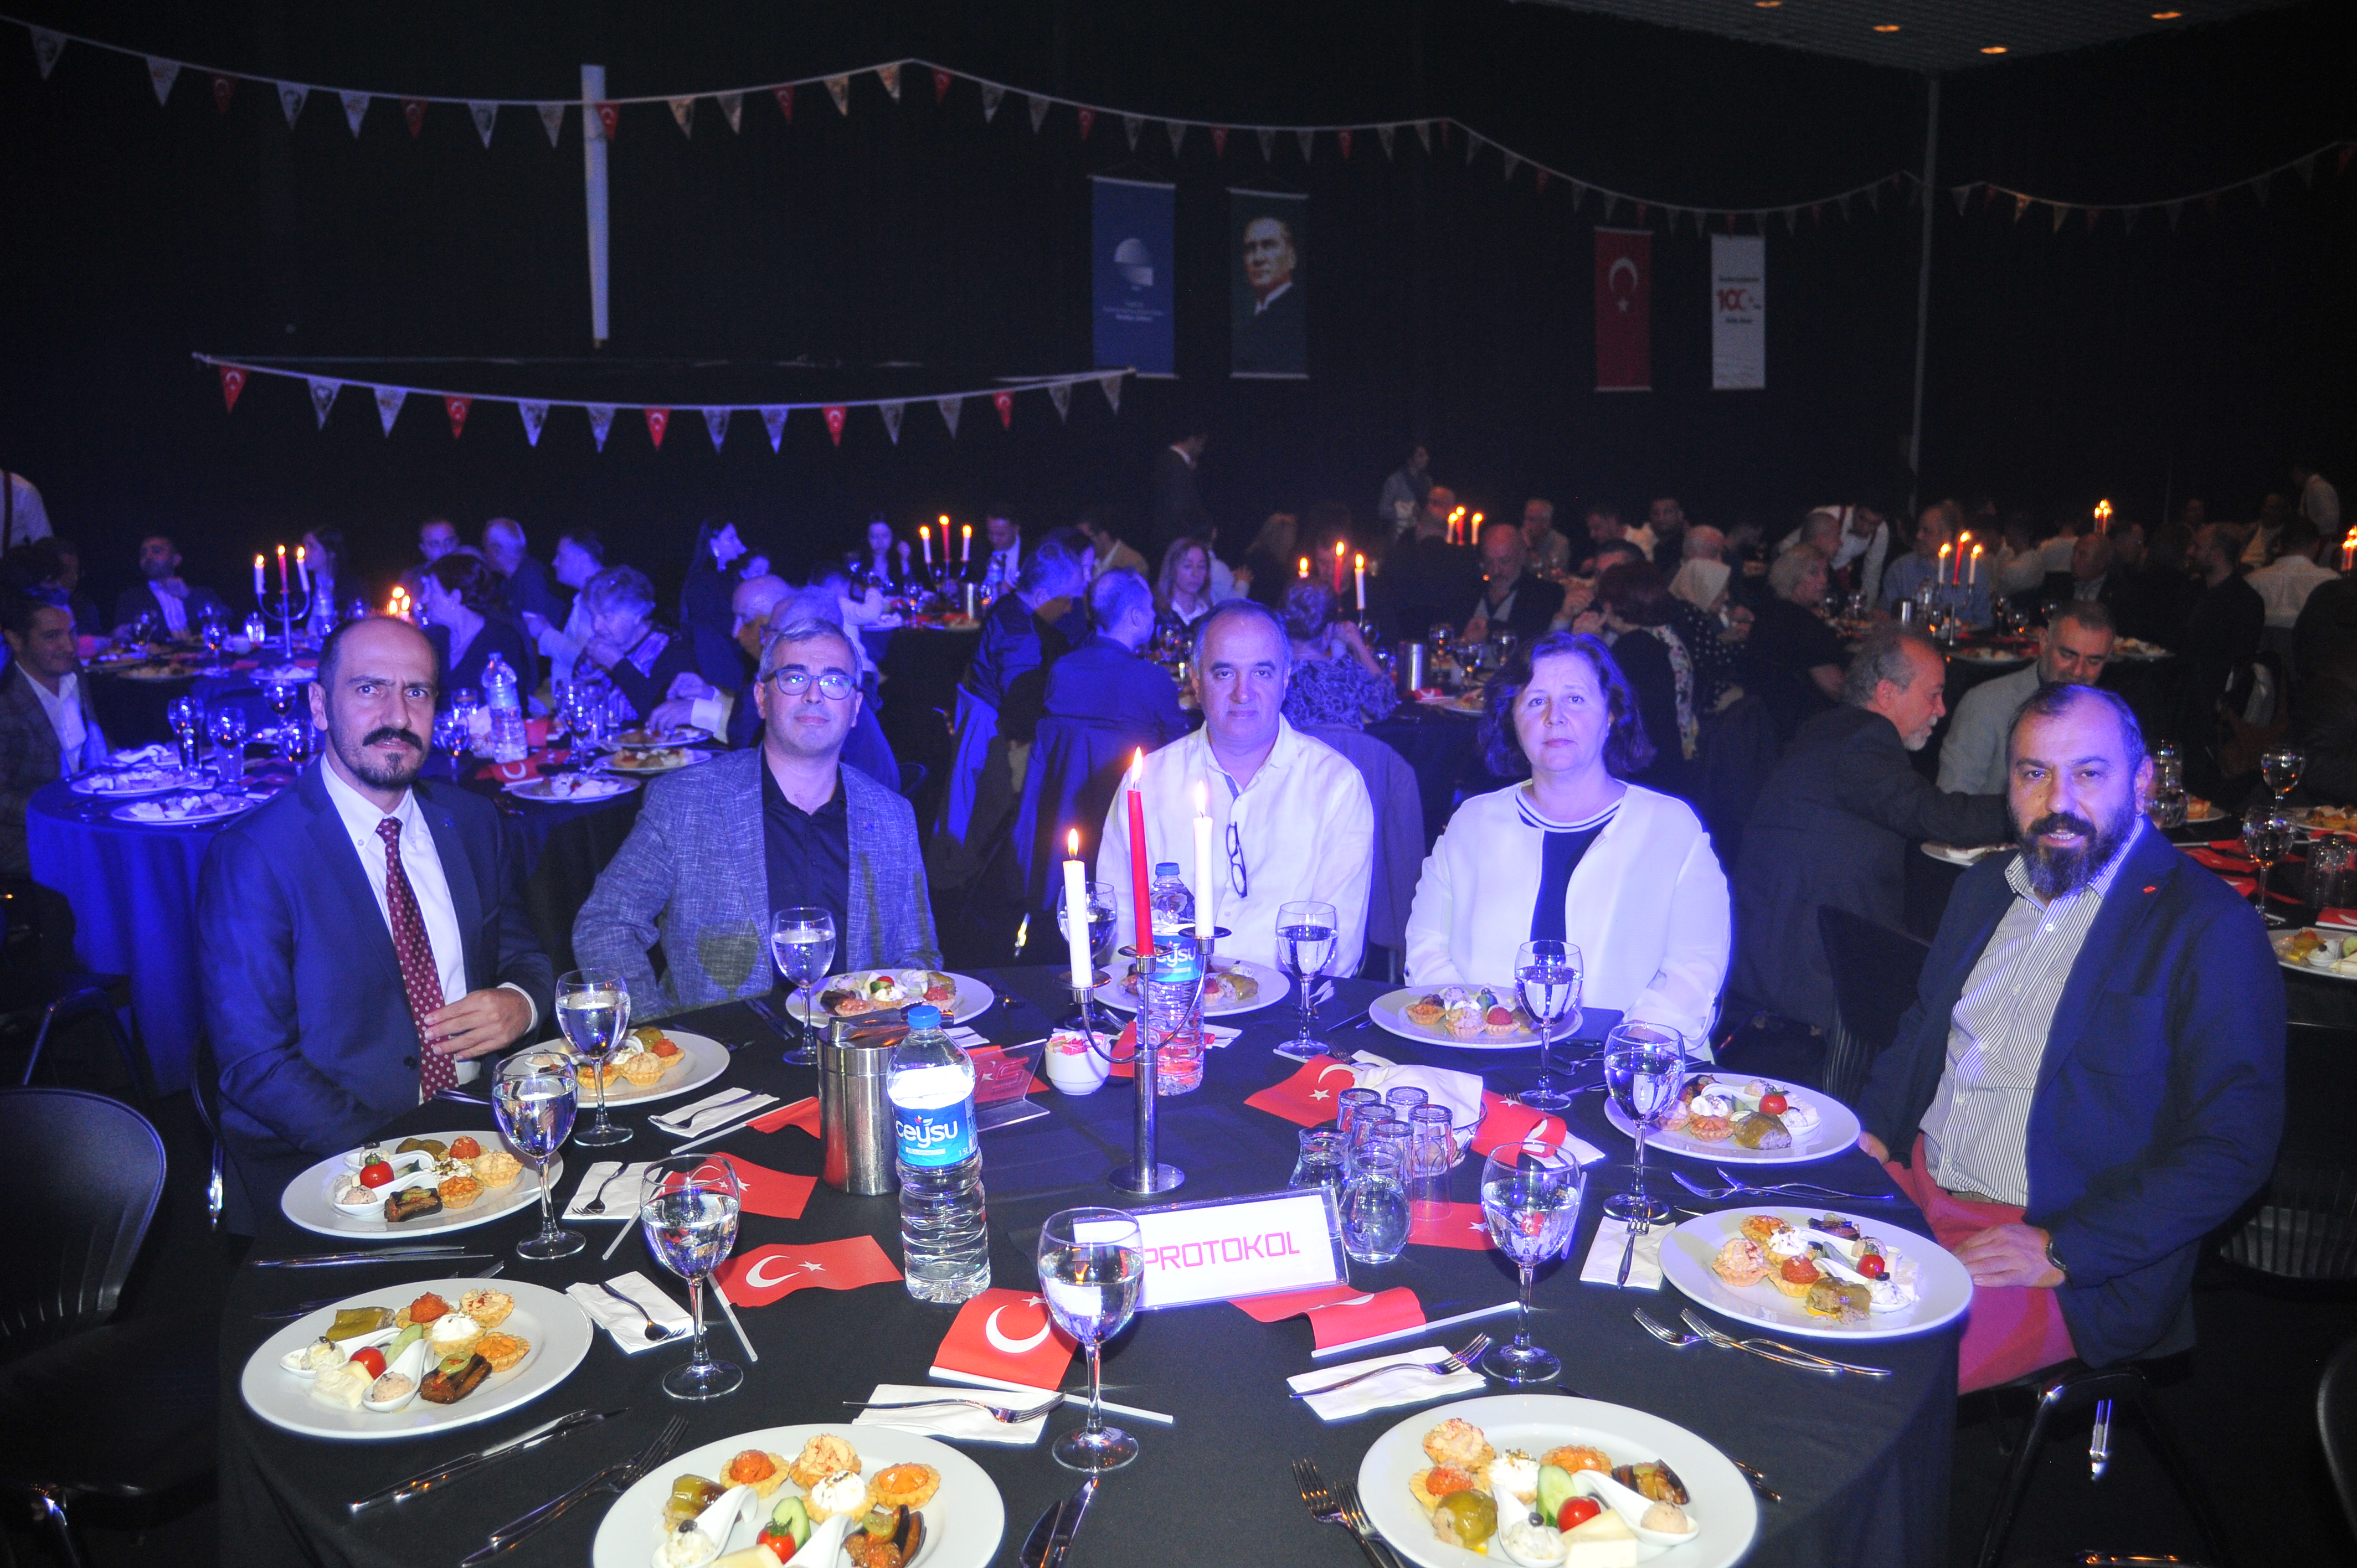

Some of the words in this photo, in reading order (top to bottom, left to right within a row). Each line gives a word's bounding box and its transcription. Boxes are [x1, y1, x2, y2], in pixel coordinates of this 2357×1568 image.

[896, 1120, 958, 1148] ceysu
[959, 1147, 970, 1158] 1.5L
[1143, 1231, 1300, 1271] PROTOKOL
